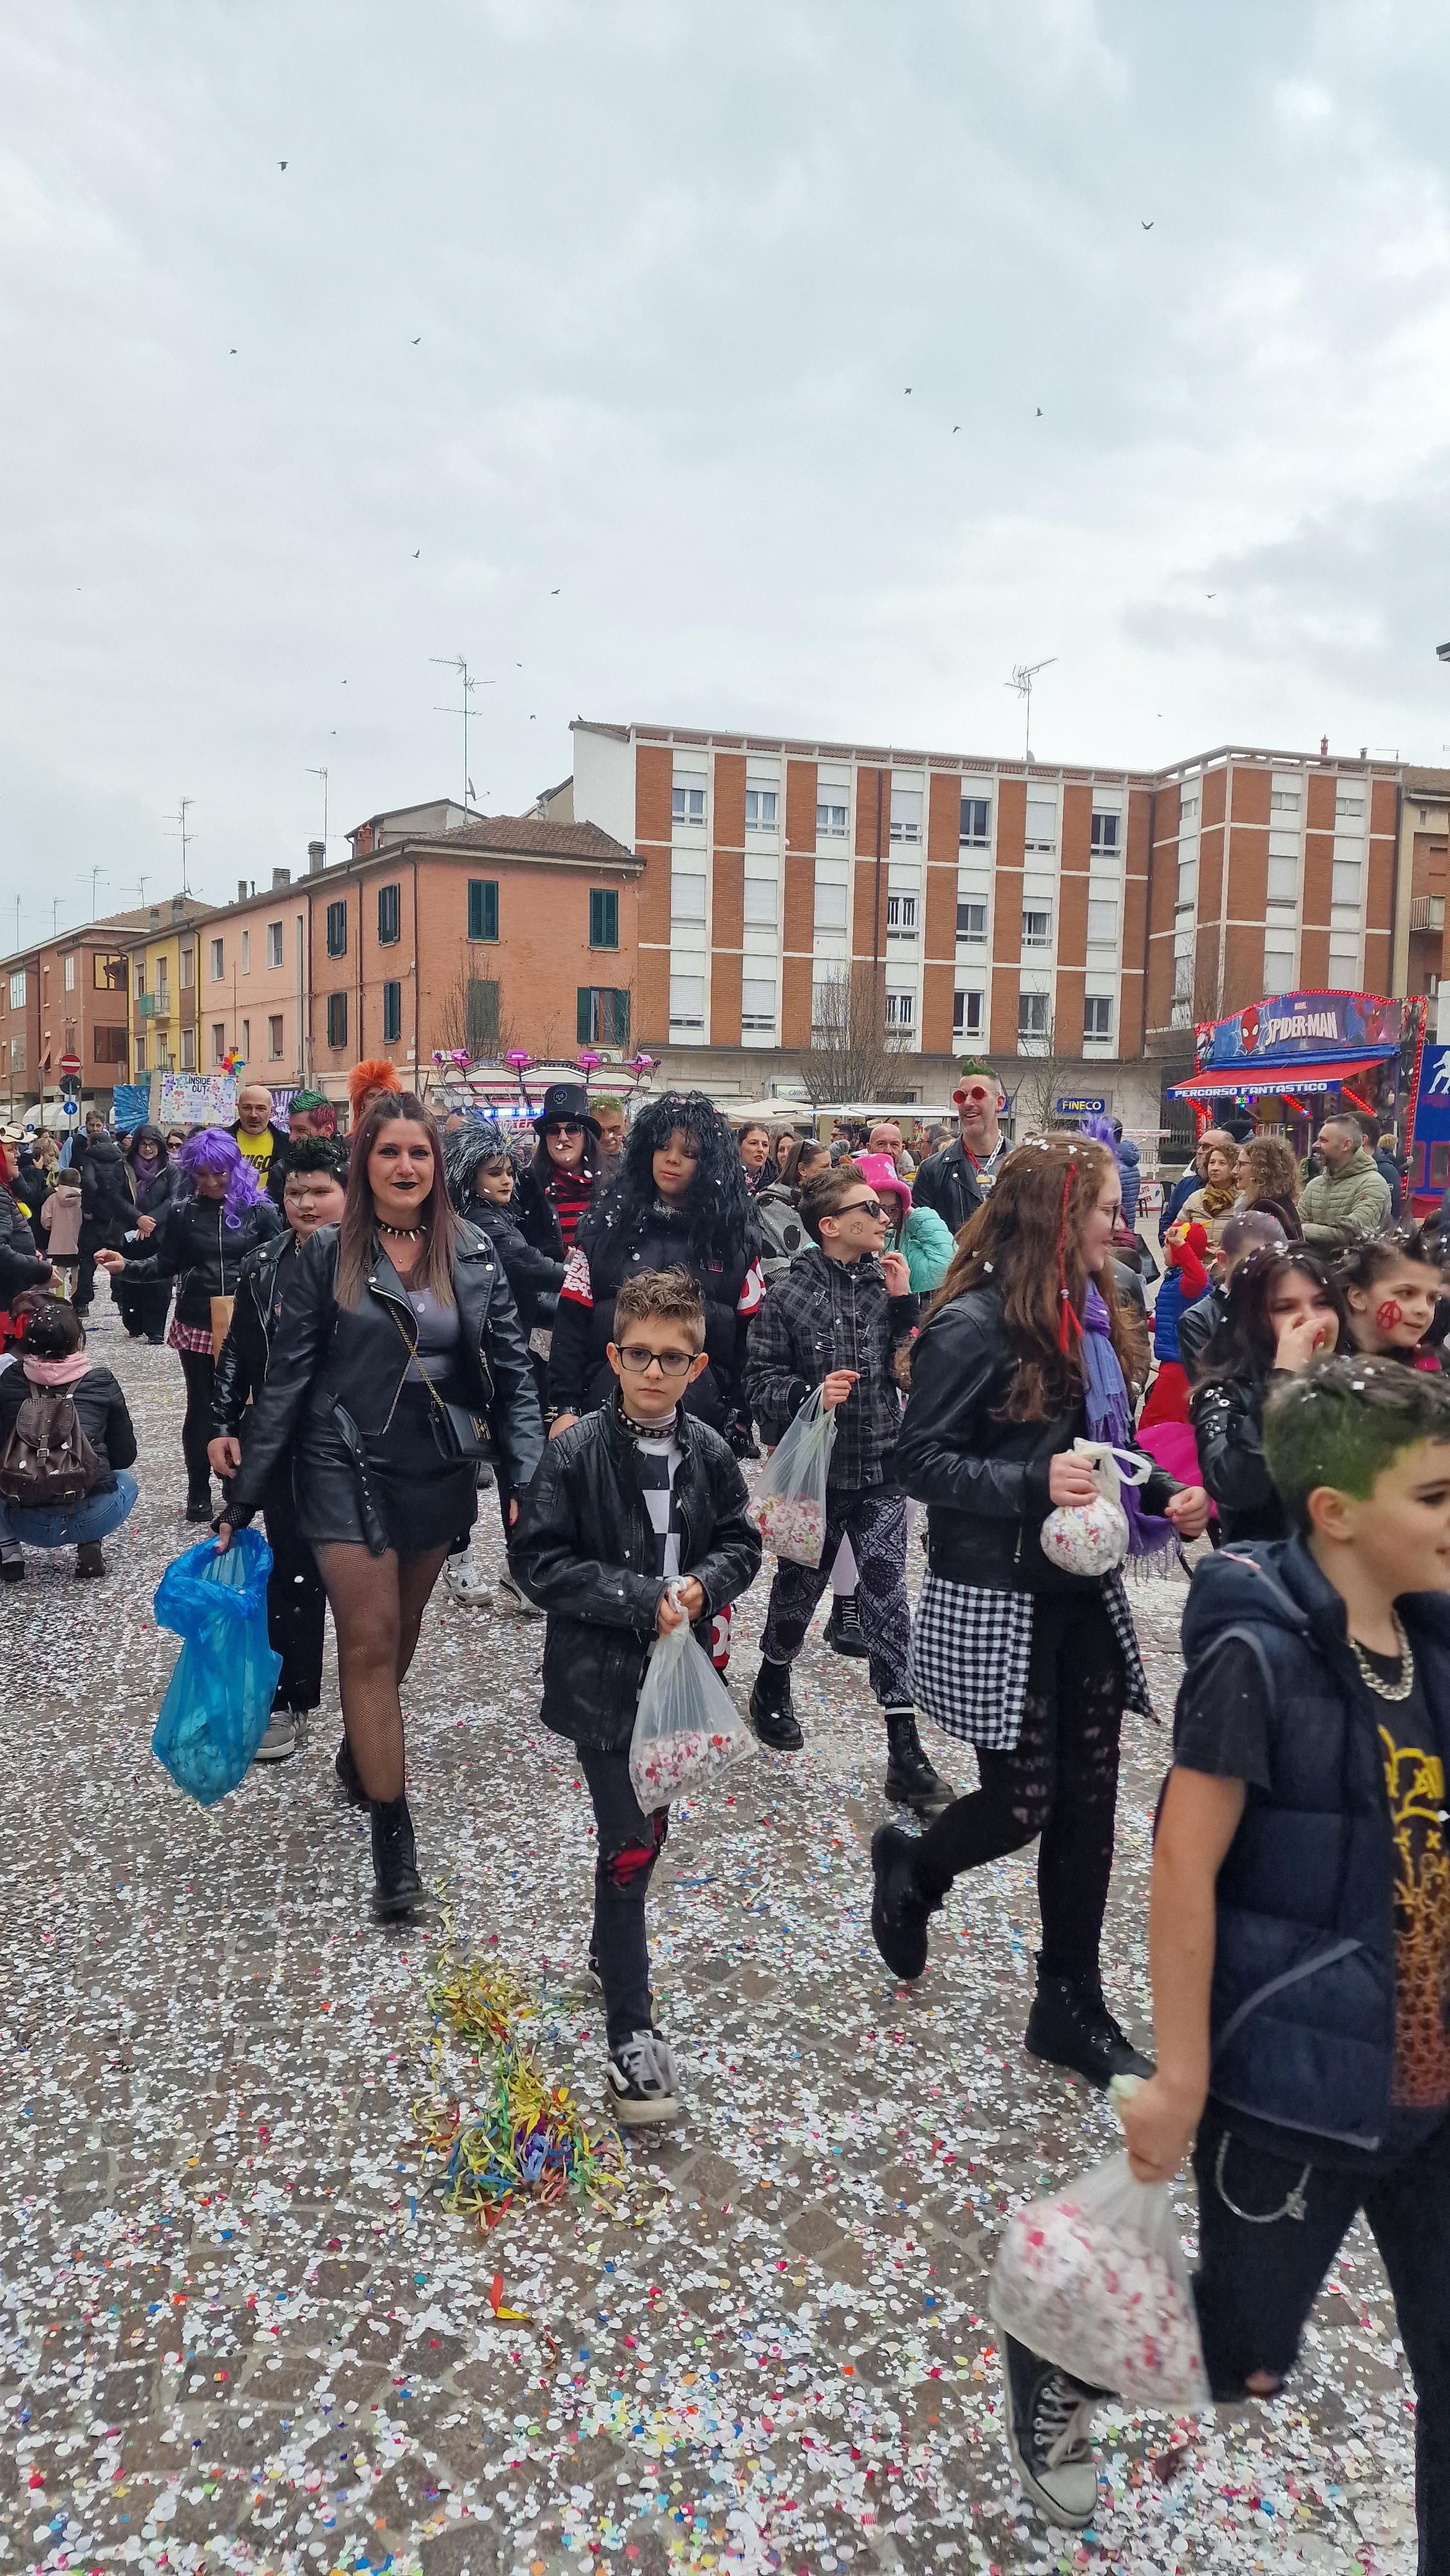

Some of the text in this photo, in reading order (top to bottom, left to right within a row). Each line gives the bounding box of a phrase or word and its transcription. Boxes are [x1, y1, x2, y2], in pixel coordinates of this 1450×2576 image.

[1265, 1012, 1338, 1046] SPIDER-MAN
[188, 1075, 212, 1085] INSIDE
[192, 1085, 208, 1095] OUT
[1174, 1083, 1328, 1098] PERCORSO FANTASTICO
[1062, 1101, 1102, 1110] FINECO
